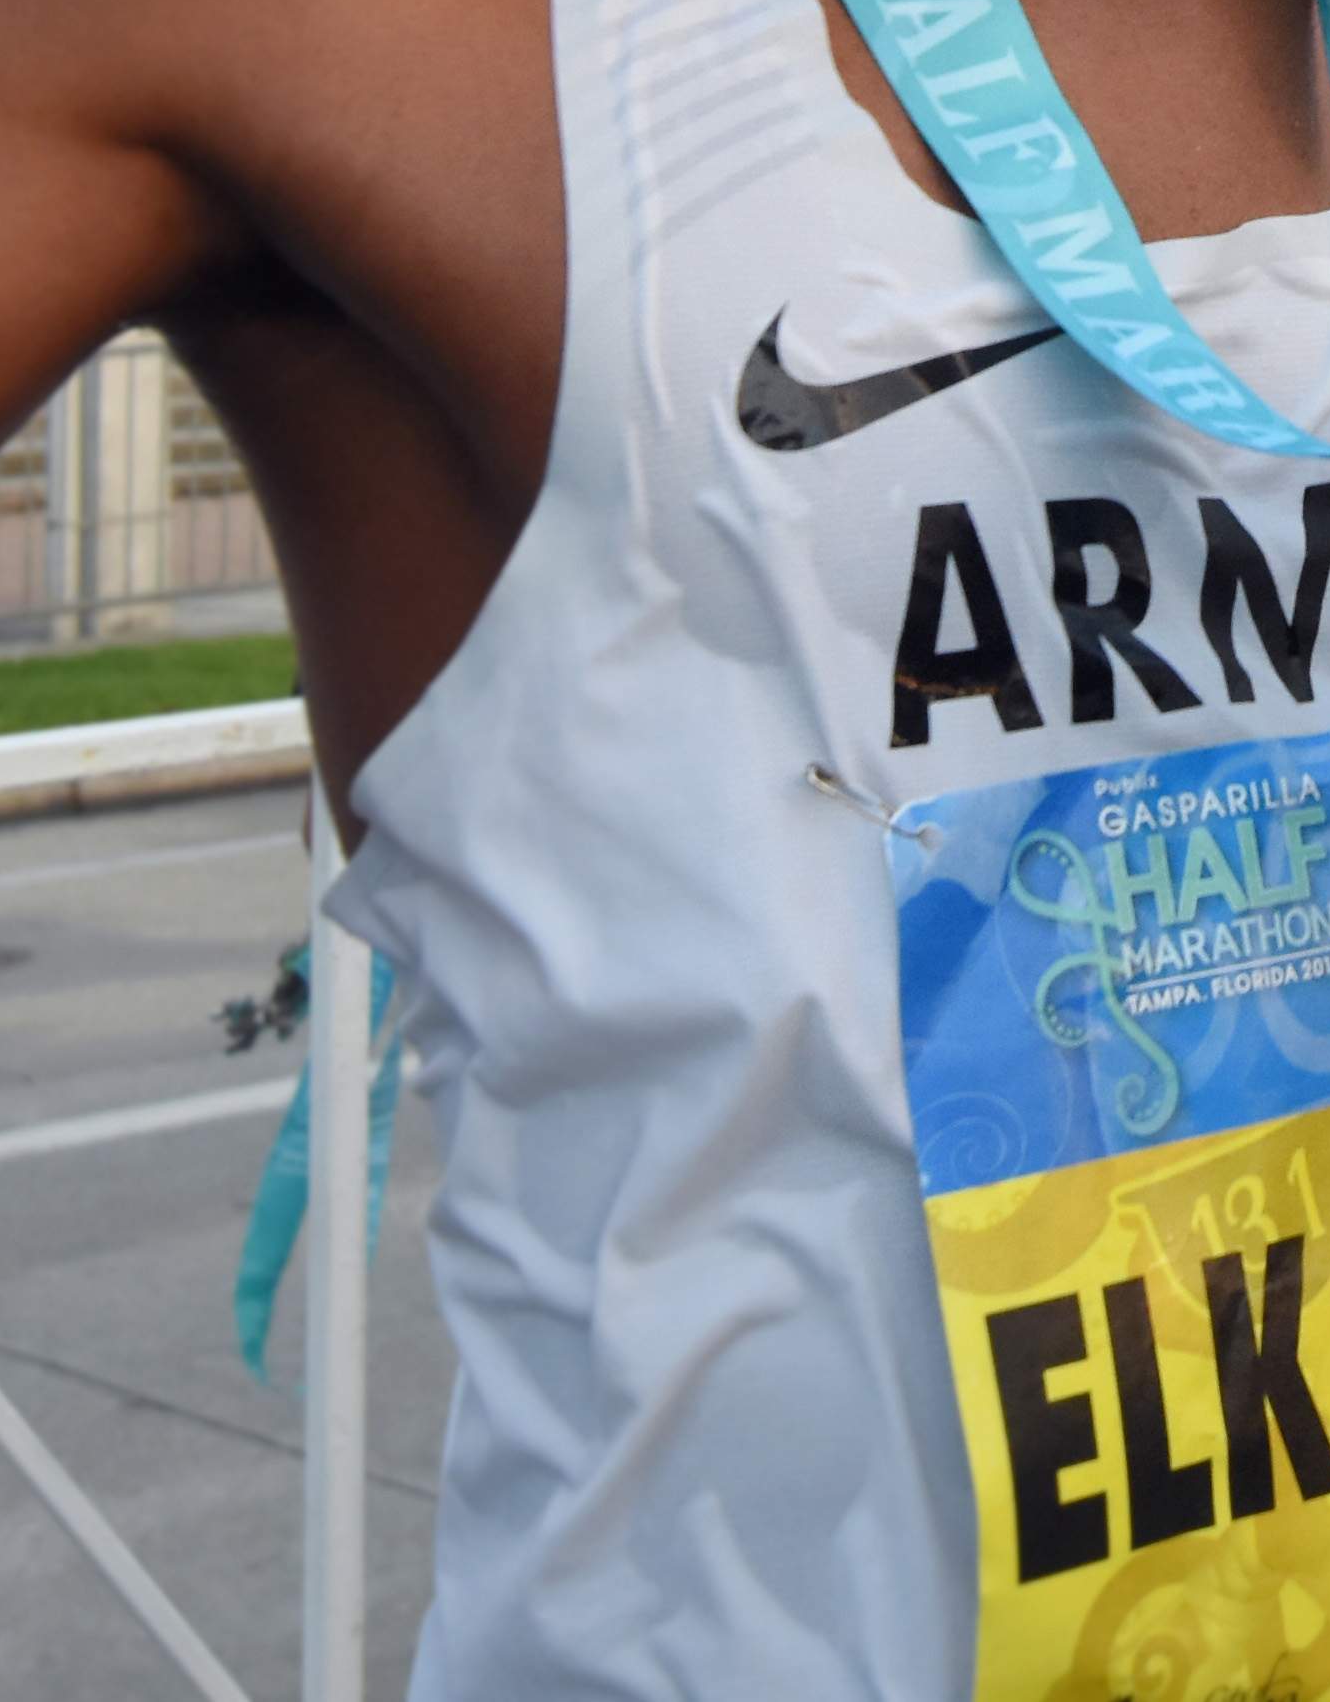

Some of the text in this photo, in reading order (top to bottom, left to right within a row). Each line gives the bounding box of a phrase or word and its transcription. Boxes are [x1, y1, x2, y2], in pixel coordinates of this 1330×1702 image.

[1097, 771, 1322, 839] GASPARILLA
[1103, 804, 1327, 934] HALF
[1210, 962, 1299, 1000] FLORIDA
